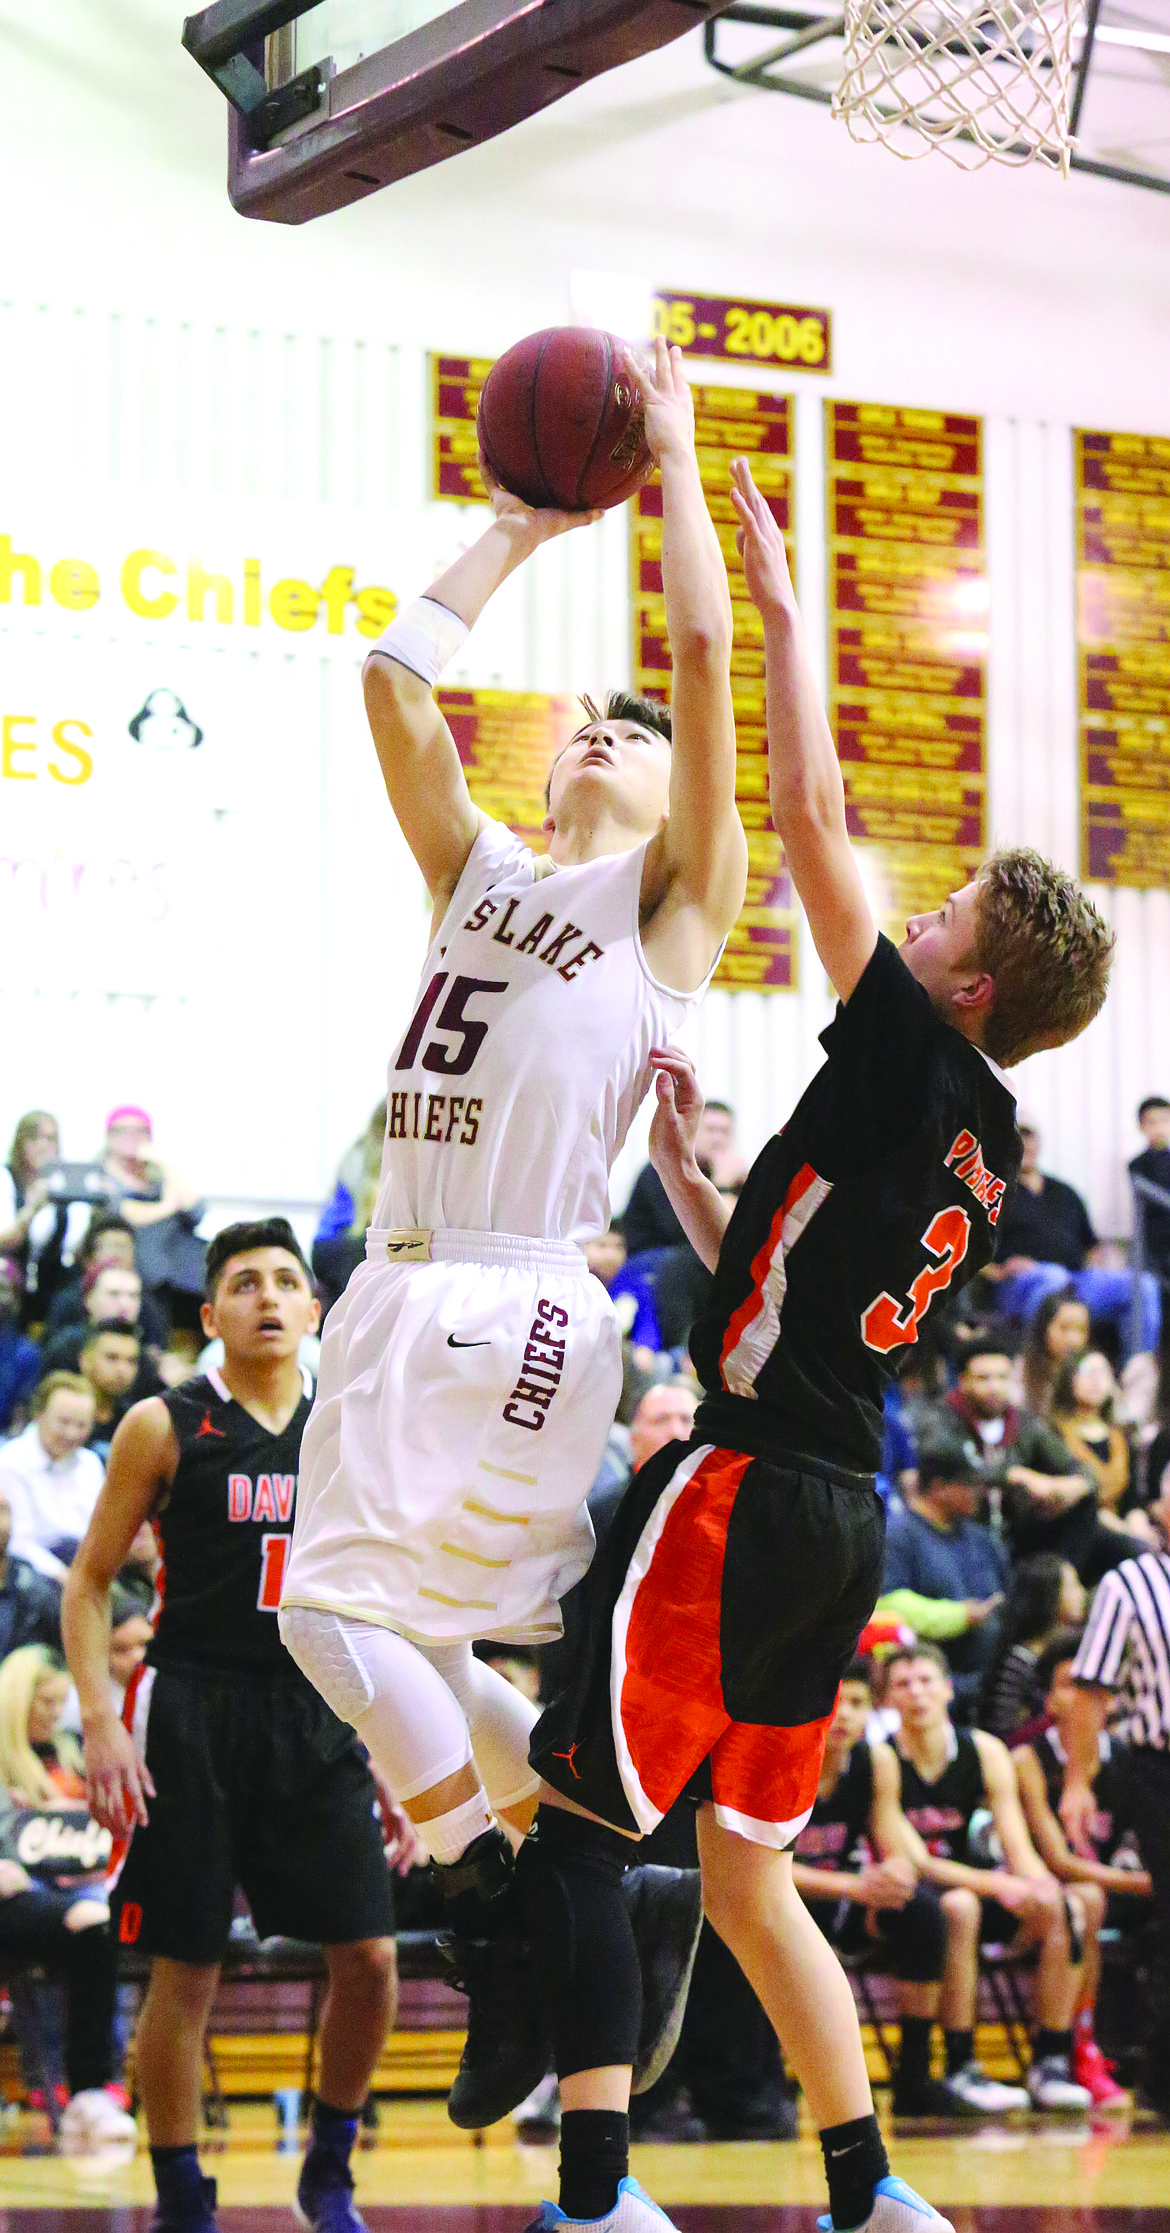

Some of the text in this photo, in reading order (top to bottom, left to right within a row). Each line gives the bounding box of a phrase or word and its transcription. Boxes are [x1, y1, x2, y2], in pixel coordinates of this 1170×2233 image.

[724, 308, 826, 364] 2006
[120, 548, 398, 640] Chiefs
[2, 714, 94, 786] ES
[394, 971, 510, 1076] 15
[860, 1204, 972, 1355] 3
[502, 1298, 569, 1432] CHIEFS
[227, 1473, 299, 1523] DAV
[257, 1533, 292, 1612] 1
